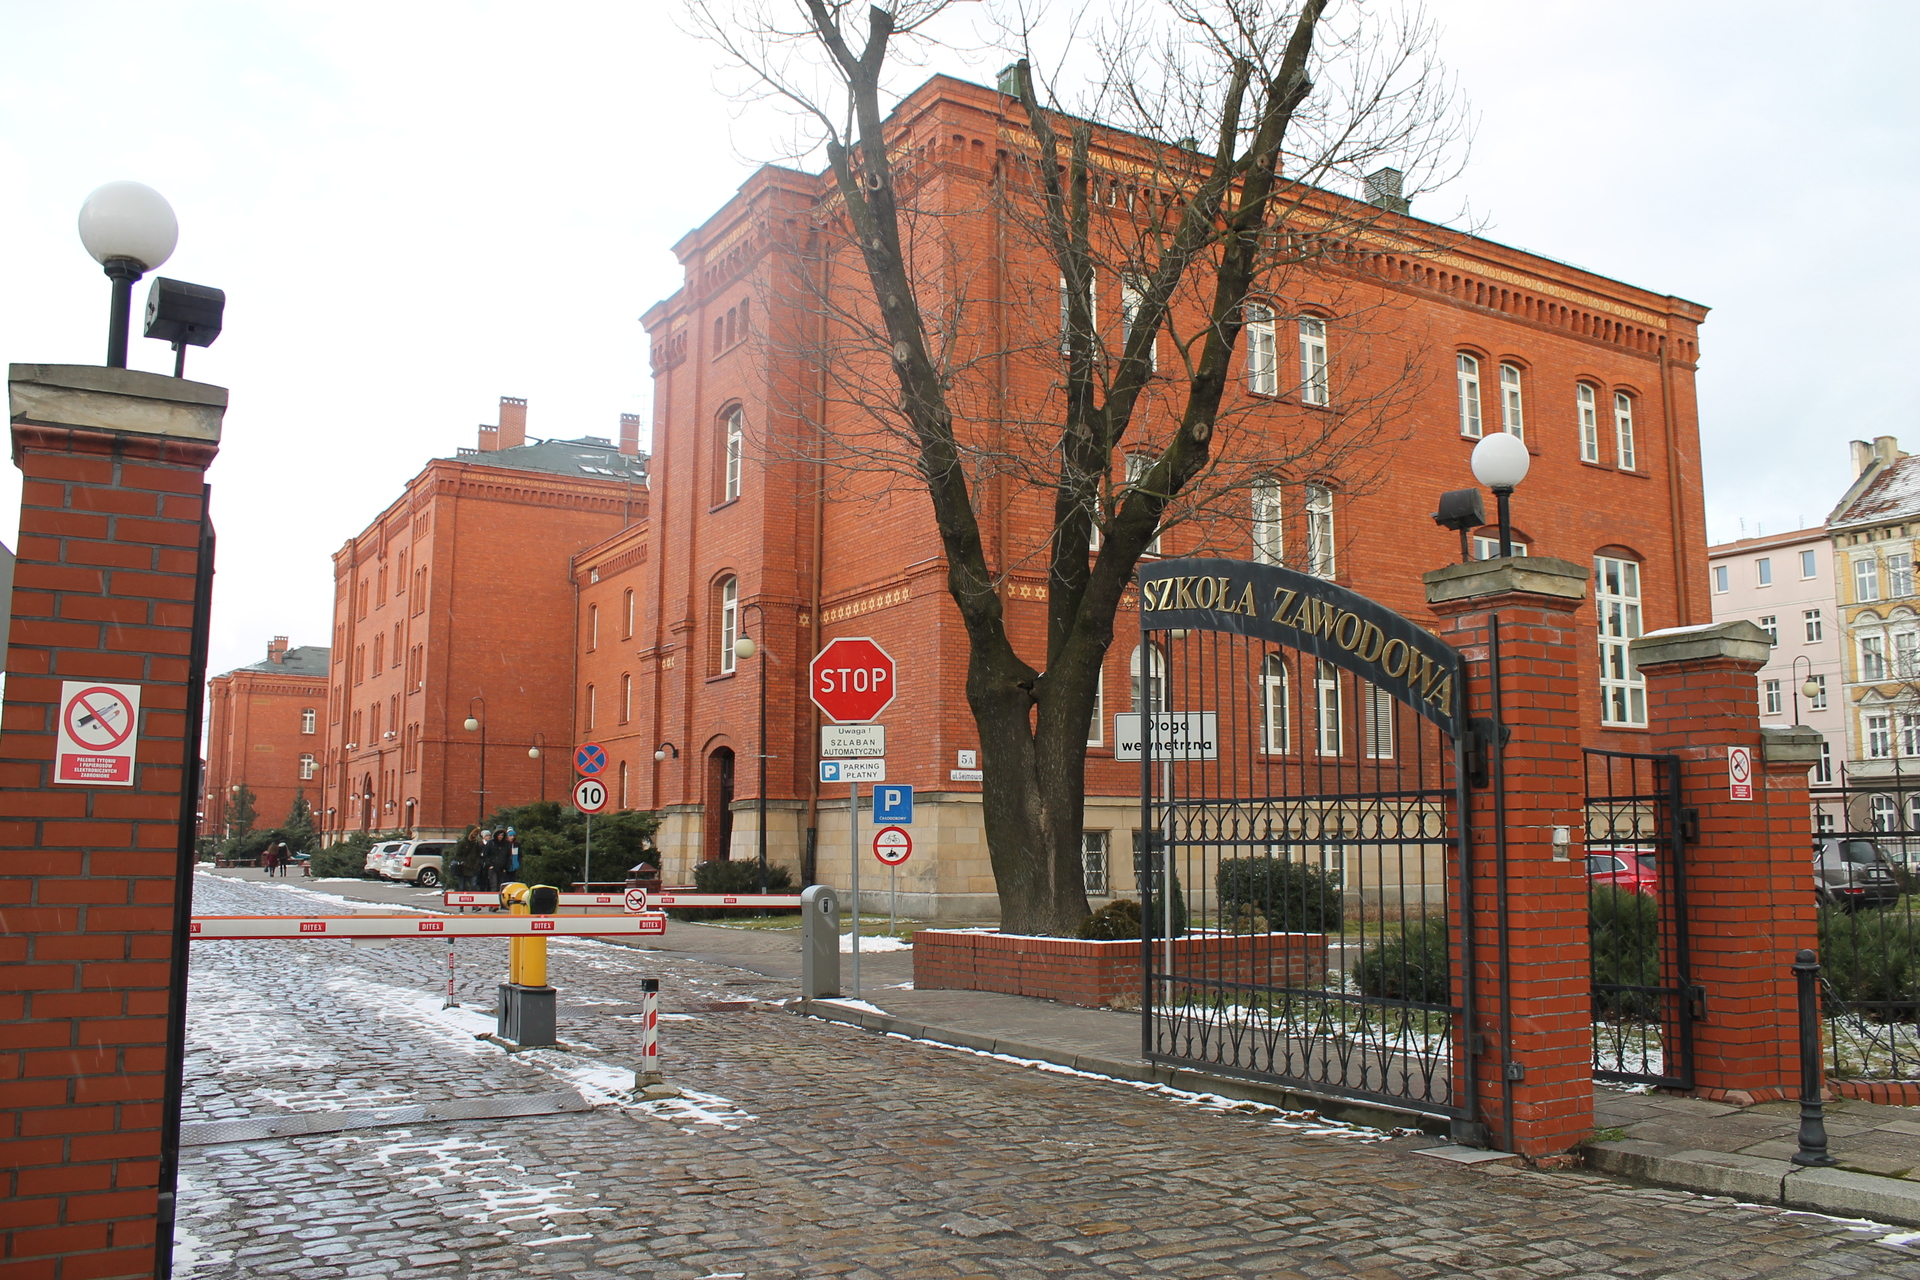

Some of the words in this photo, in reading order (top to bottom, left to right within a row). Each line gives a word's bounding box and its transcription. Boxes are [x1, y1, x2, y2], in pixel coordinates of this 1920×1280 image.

[1143, 575, 1257, 618] SZKOŁA
[1271, 586, 1453, 718] ZAWODOWA
[820, 667, 887, 693] STOP
[823, 747, 883, 756] AUTOMATYCZNY
[824, 765, 837, 778] P
[581, 787, 602, 805] 10
[884, 789, 901, 811] P
[303, 923, 323, 931] DITEX
